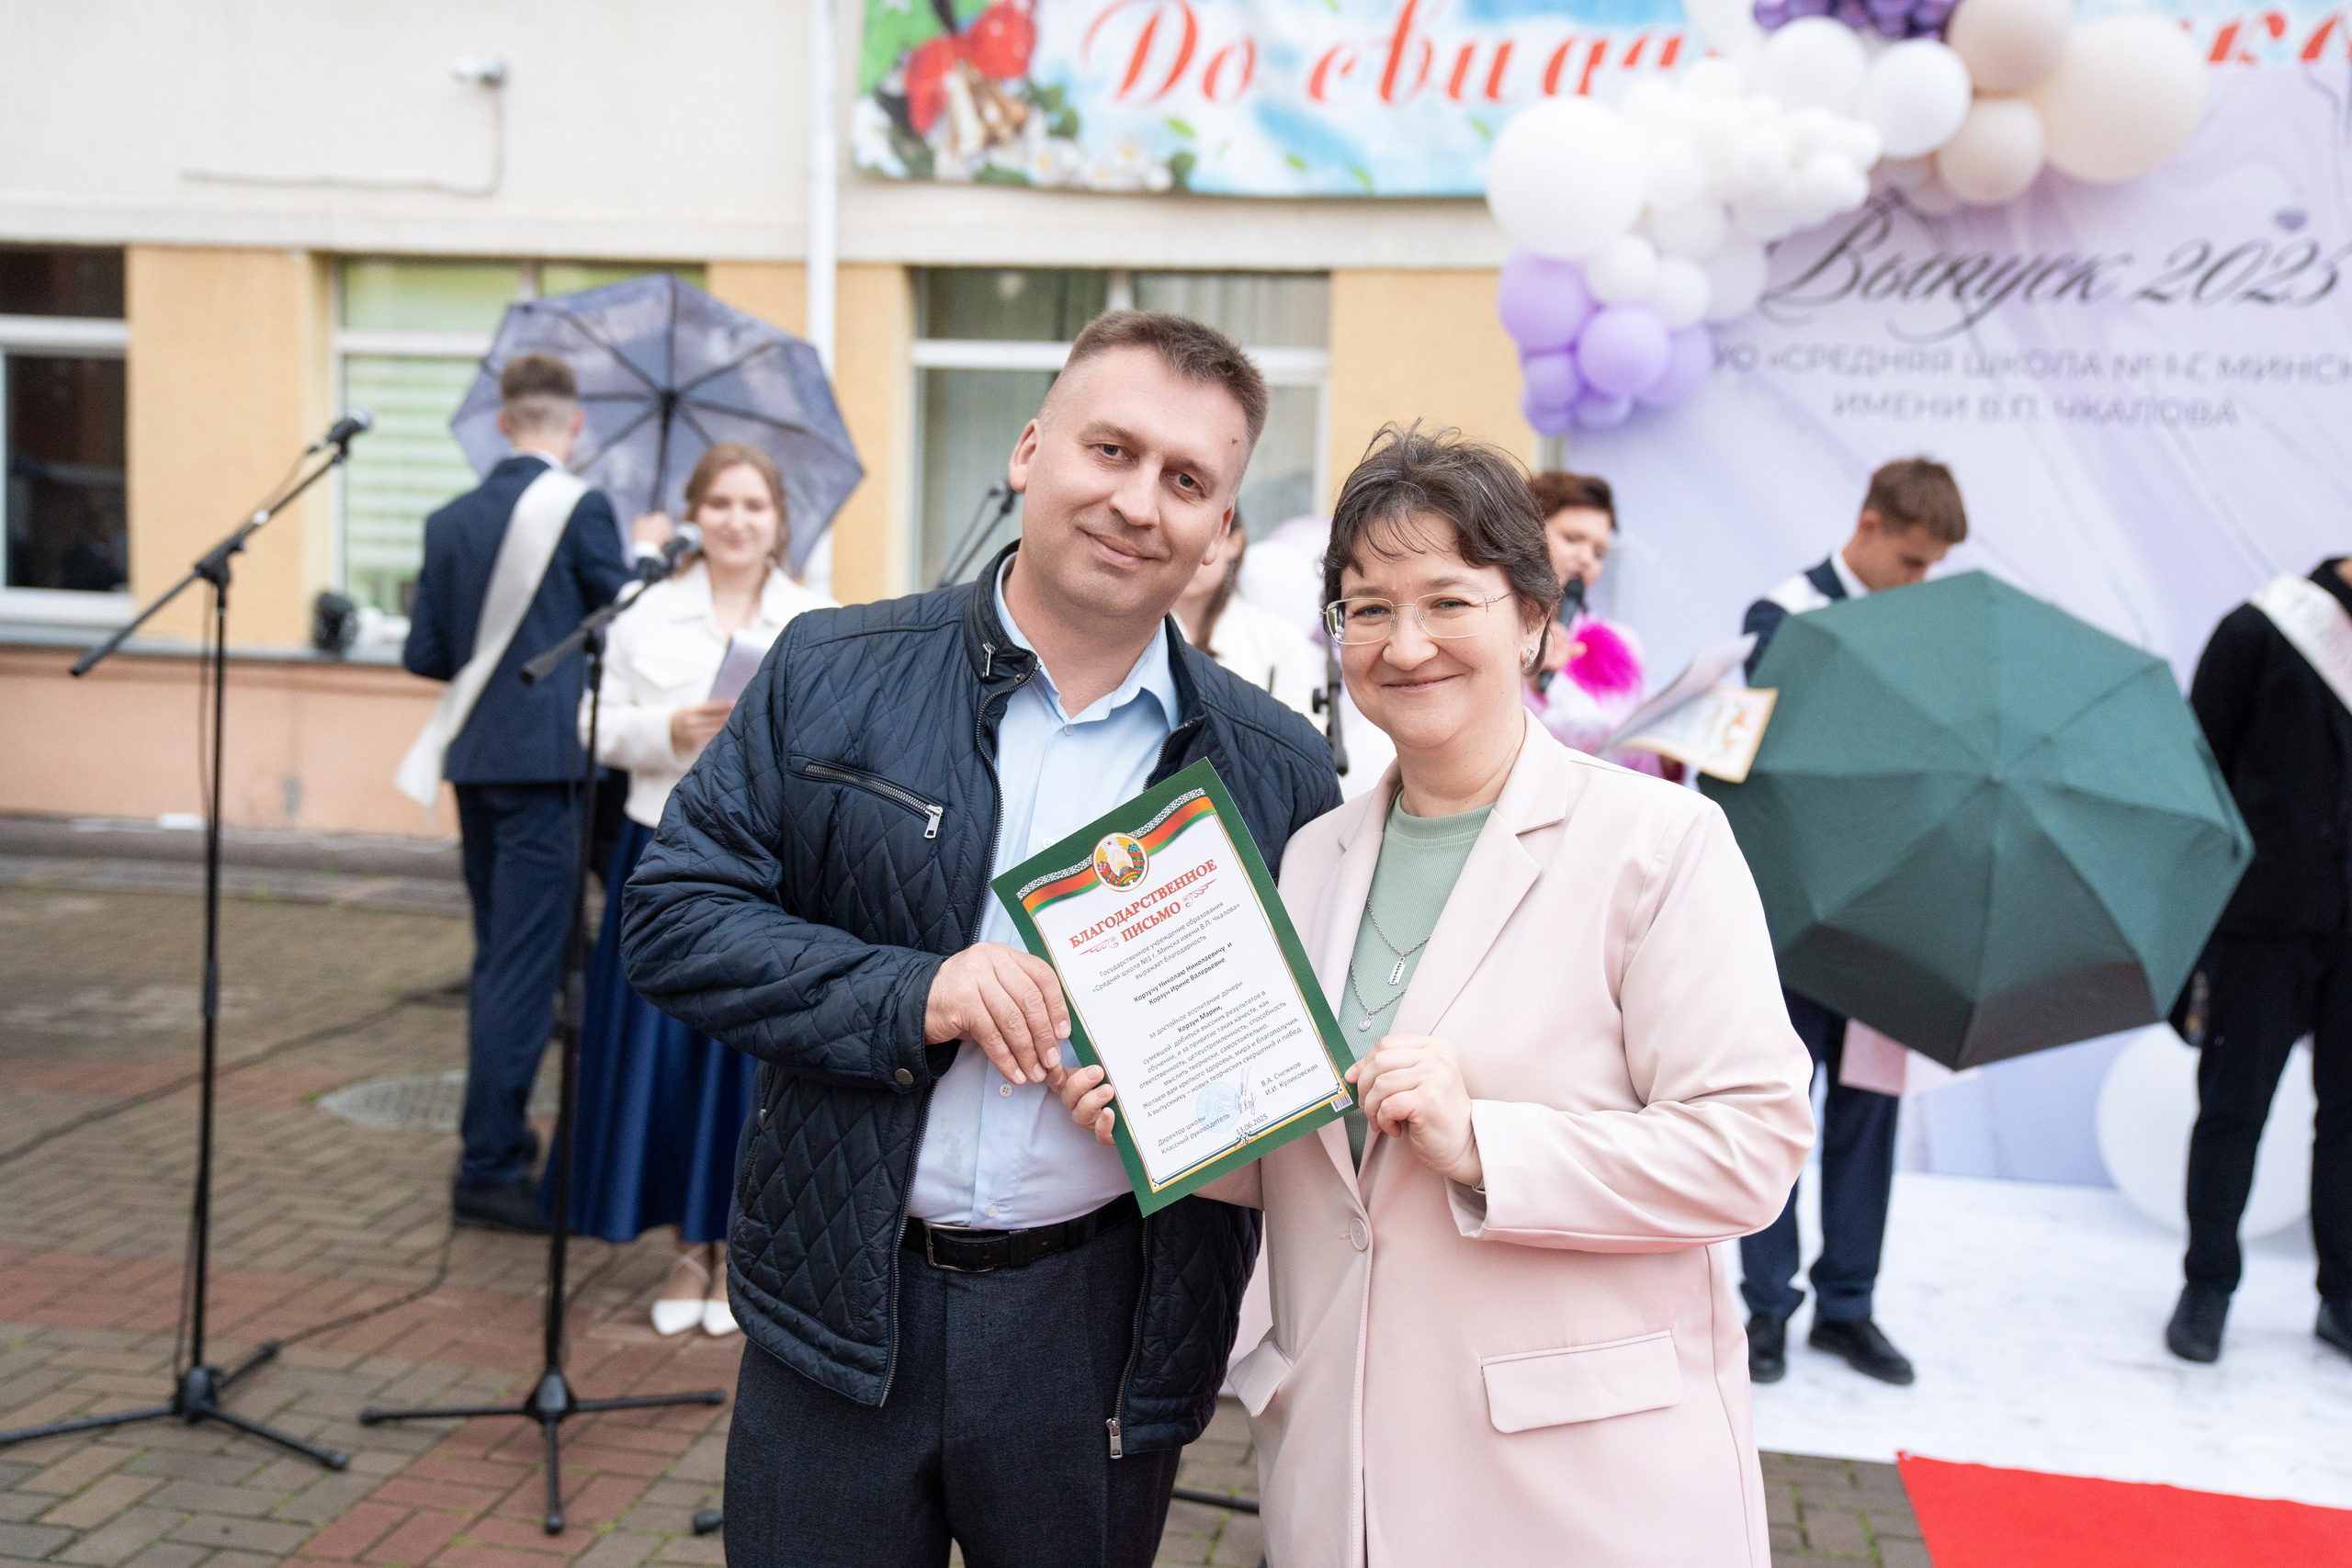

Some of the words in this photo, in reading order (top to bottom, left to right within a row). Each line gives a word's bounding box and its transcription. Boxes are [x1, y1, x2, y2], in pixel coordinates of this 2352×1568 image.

[1080, 0, 1256, 107] До
[1757, 188, 2133, 344] Выпуск
[2124, 236, 2352, 309] 2025
[1962, 347, 2106, 379] ШКОЛА
[1831, 388, 1970, 422] ИМЕНИ
[2051, 394, 2240, 430] ЧКАЛОВА
[1069, 860, 1216, 947] БЛАГОДАРСТВЕННОЕ
[1121, 901, 1181, 942] ПИСЬМО
[1091, 974, 1120, 992] «Средняя
[1121, 963, 1140, 976] школа
[1139, 954, 1151, 964] №1
[1157, 939, 1180, 954] Минска
[1180, 927, 1200, 942] имени
[1199, 919, 1212, 930] В.П.
[1211, 903, 1239, 920] Чкалова»
[1099, 946, 1149, 976] Государственное
[1149, 924, 1185, 949] учреждение
[1185, 901, 1223, 927] образования
[1135, 959, 1163, 979] выражает
[1163, 935, 1206, 962] благодарность
[1133, 985, 1159, 1002] Корзуну
[1158, 969, 1185, 987] Николаю
[1185, 945, 1225, 971] Николаевичу
[1148, 989, 1170, 1005] Корзун
[1170, 978, 1190, 992] Ирине
[1189, 957, 1225, 980] Валерьевне
[1143, 1043, 1171, 1064] сумевшей
[1173, 1028, 1200, 1047] добиться
[1200, 1014, 1225, 1031] высоких
[1225, 993, 1261, 1017] результатов
[1157, 1013, 1186, 1035] достойное
[1187, 994, 1220, 1016] воспитание
[1221, 981, 1242, 998] дочери
[1177, 1018, 1199, 1032] Корзун
[1199, 1005, 1222, 1020] Марии,
[1138, 1060, 1187, 1089] ответственность,
[1187, 1024, 1249, 1061] целеустремленность,
[1249, 1002, 1286, 1025] способность
[1142, 1093, 1166, 1109] Желаем
[1166, 1086, 1178, 1095] вам
[1178, 1070, 1204, 1088] крепкого
[1205, 1055, 1234, 1073] здоровья,
[1234, 1043, 1250, 1056] мира
[1255, 1017, 1299, 1043] благополучия.
[1147, 1055, 1177, 1073] обучении,
[1189, 1030, 1216, 1048] привитие
[1216, 1020, 1234, 1032] таких
[1233, 1007, 1258, 1022] качеств,
[1258, 999, 1269, 1009] как
[1163, 1069, 1188, 1086] мыслить
[1188, 1052, 1219, 1070] творчески,
[1220, 1023, 1268, 1053] самостоятельно.
[1152, 1093, 1185, 1114] выпускнику
[1191, 1079, 1209, 1092] новых
[1209, 1060, 1242, 1081] творческих
[1242, 1040, 1275, 1063] свершений
[1281, 1027, 1303, 1041] побед.
[1261, 1077, 1273, 1087] В.А.
[1273, 1061, 1301, 1079] Снежков
[1264, 1085, 1279, 1095] И.И.
[1278, 1064, 1317, 1088] Куликовская
[1158, 1127, 1185, 1146] Директор
[1185, 1115, 1205, 1129] школы
[1160, 1134, 1189, 1154] Классный
[1190, 1114, 1229, 1139] руководитель
[1236, 1112, 1268, 1134] 13.06.2025
